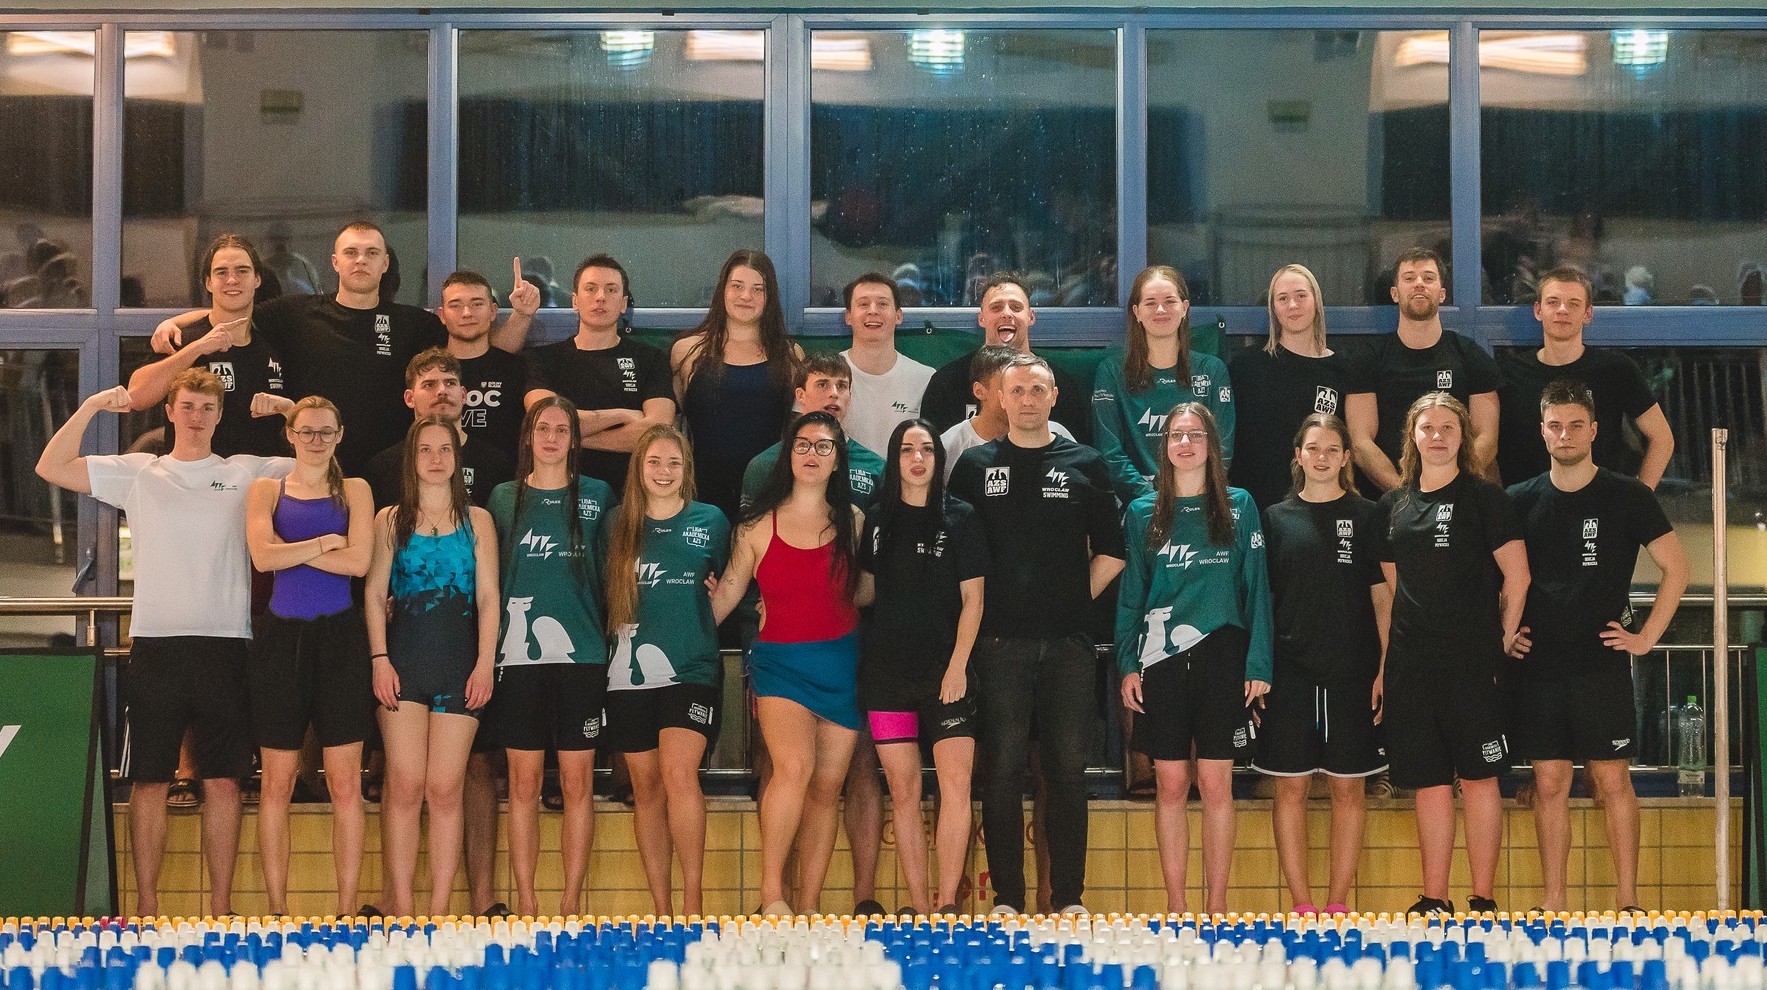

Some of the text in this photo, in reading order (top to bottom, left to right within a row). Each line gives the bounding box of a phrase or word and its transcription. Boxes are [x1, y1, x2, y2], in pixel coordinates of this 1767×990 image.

[466, 390, 502, 407] OC
[1317, 397, 1336, 409] AZS
[1315, 403, 1335, 414] AWF
[461, 409, 487, 428] VE
[987, 486, 1007, 494] AWF
